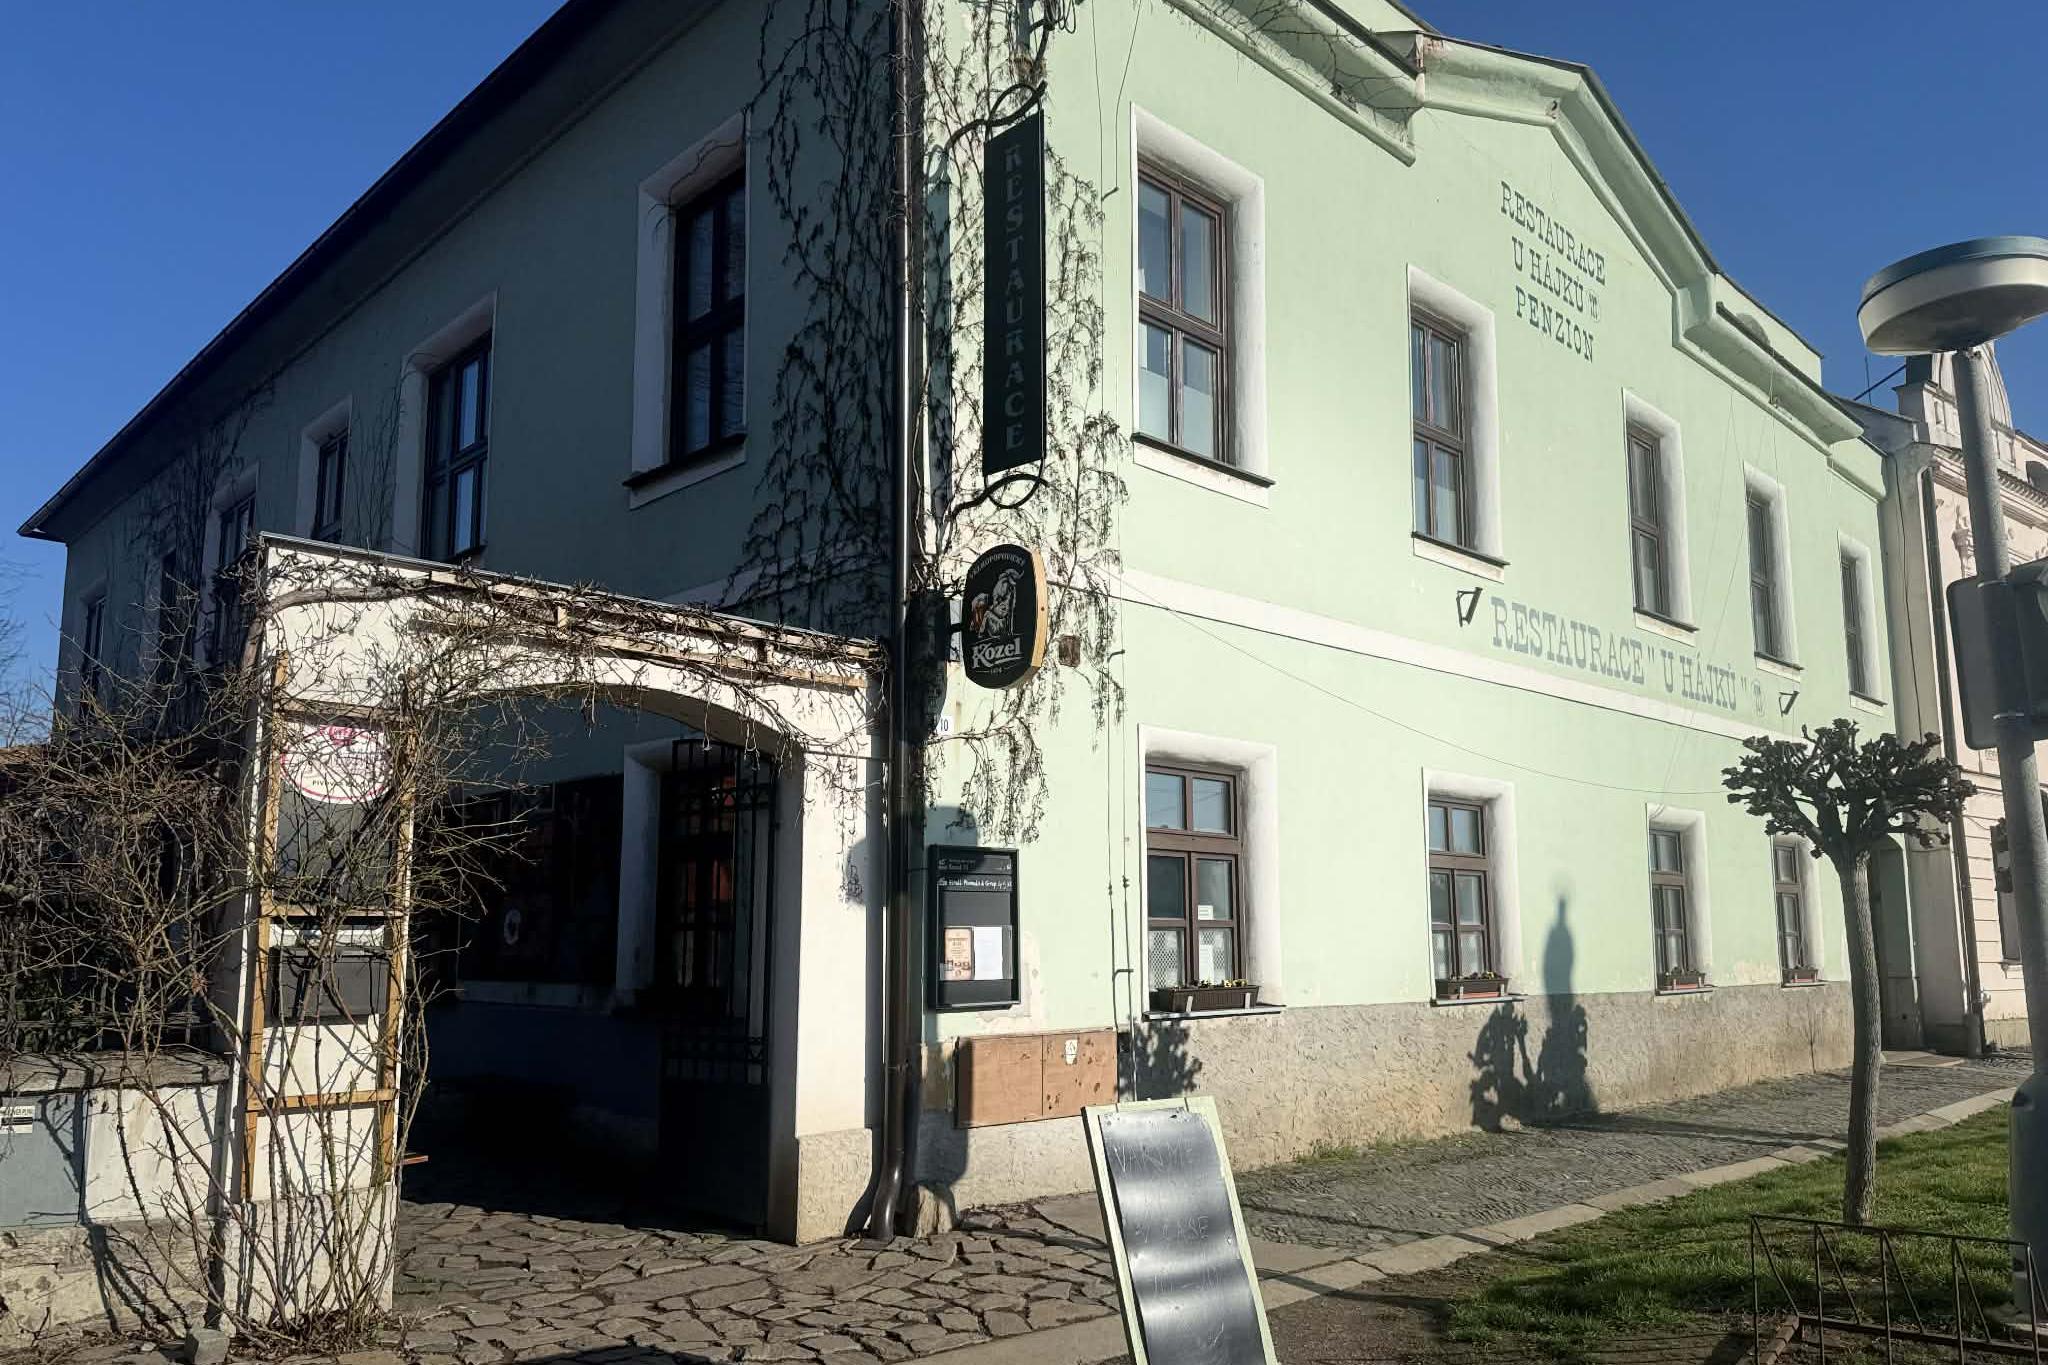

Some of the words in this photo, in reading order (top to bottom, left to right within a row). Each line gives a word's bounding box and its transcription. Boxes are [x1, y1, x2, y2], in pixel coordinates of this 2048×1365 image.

[1500, 180, 1606, 286] RESTAURACE
[1511, 235, 1524, 273] U
[1528, 246, 1584, 314] HÁJKŮ
[1004, 144, 1025, 450] RESTAURACE
[1515, 284, 1595, 364] PENZION
[971, 636, 1025, 669] Kozel
[1490, 596, 1646, 686] RESTAURACE
